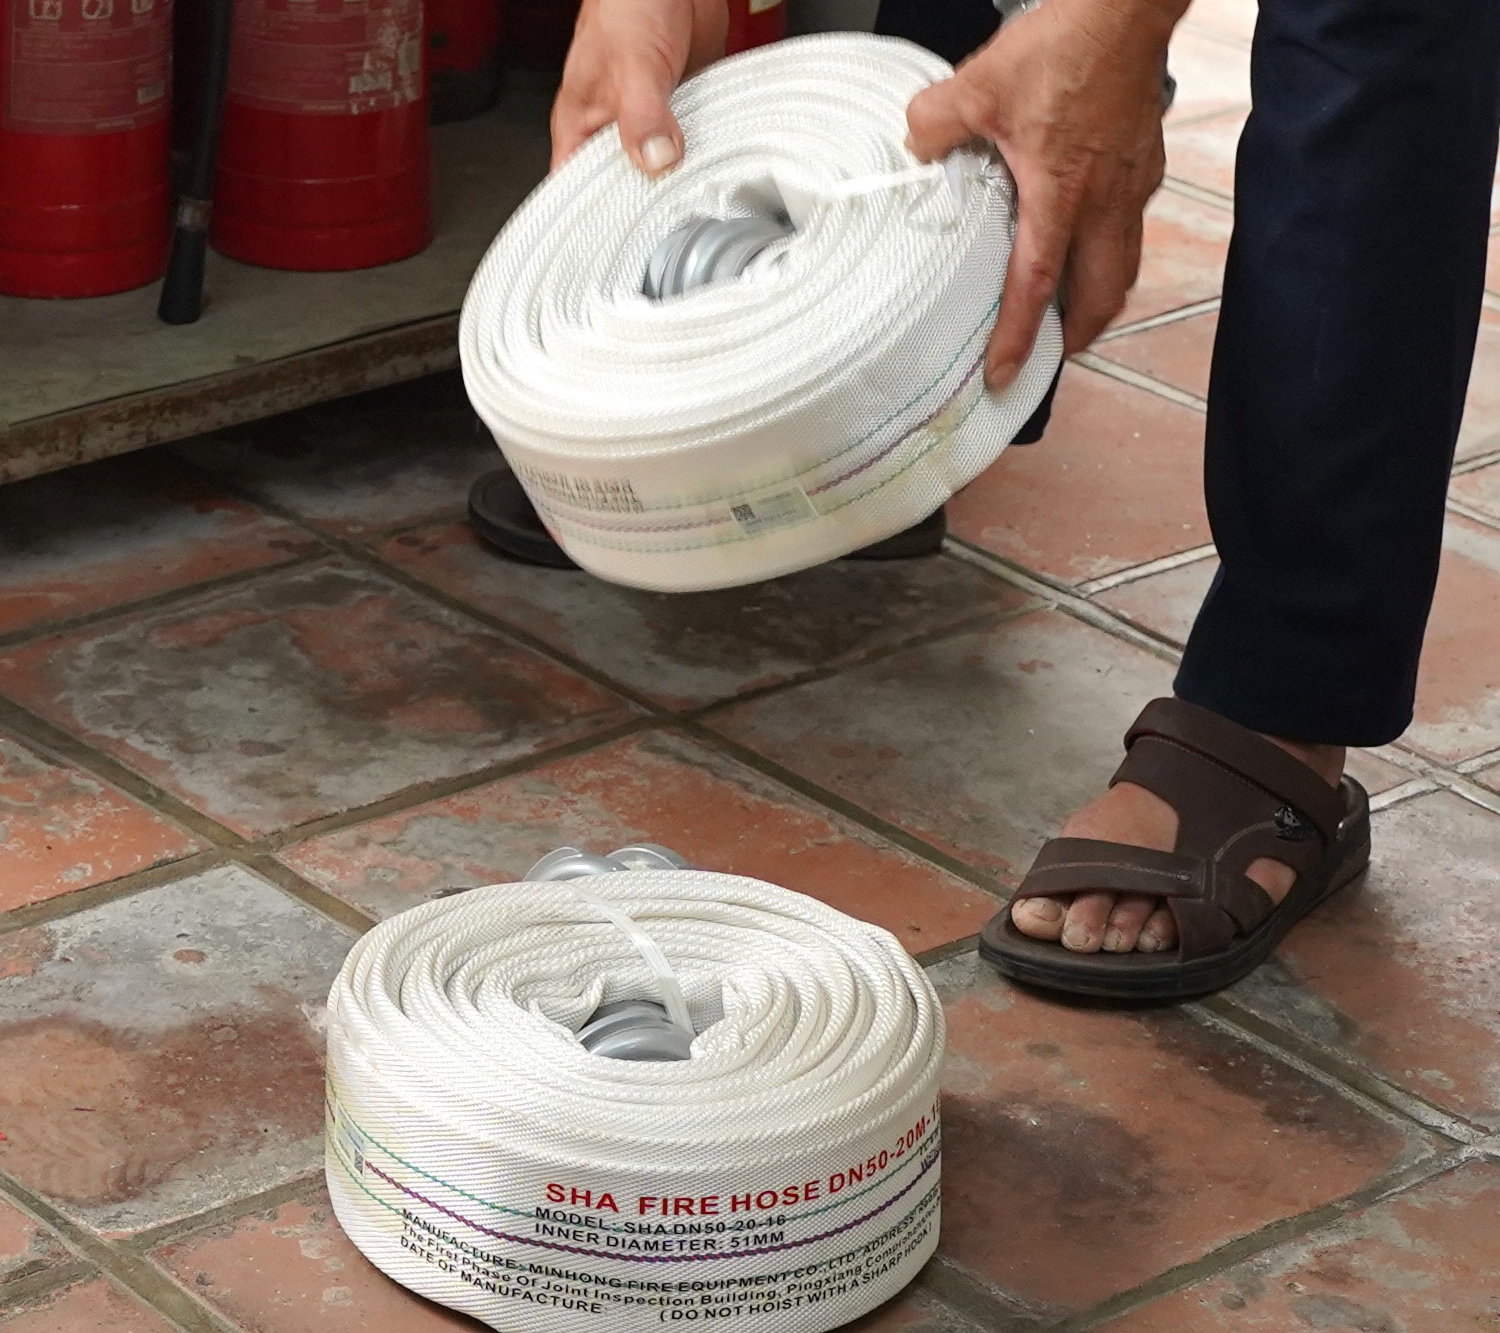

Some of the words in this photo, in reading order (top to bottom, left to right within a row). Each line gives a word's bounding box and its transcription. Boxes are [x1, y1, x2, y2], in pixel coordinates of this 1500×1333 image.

[546, 1183, 619, 1213] SHA
[638, 1195, 720, 1216] FIRE
[730, 1180, 821, 1213] HOSE
[535, 1206, 617, 1232] MODEL:
[535, 1223, 599, 1244] INNER
[606, 1235, 723, 1252] DIAMETER:
[731, 1231, 784, 1248] 51MM
[400, 1235, 434, 1264] DATE
[438, 1259, 457, 1274] OF
[705, 1306, 744, 1319] NOT
[749, 1296, 804, 1314] HOIST
[807, 1283, 846, 1304] WITH
[850, 1279, 859, 1290] A
[862, 1251, 903, 1284] SHARP
[402, 1221, 424, 1243] The
[427, 1237, 457, 1262] First
[462, 1257, 511, 1282] Phase
[516, 1275, 539, 1288] Of
[542, 1280, 588, 1297] Joint
[594, 1289, 694, 1307] Inspection
[701, 1289, 781, 1306] Building,
[787, 1265, 862, 1294] Pingxiang
[529, 1263, 621, 1288] MINHONG
[628, 1280, 672, 1293] FIRE
[678, 1271, 788, 1293] EQUIPMENT
